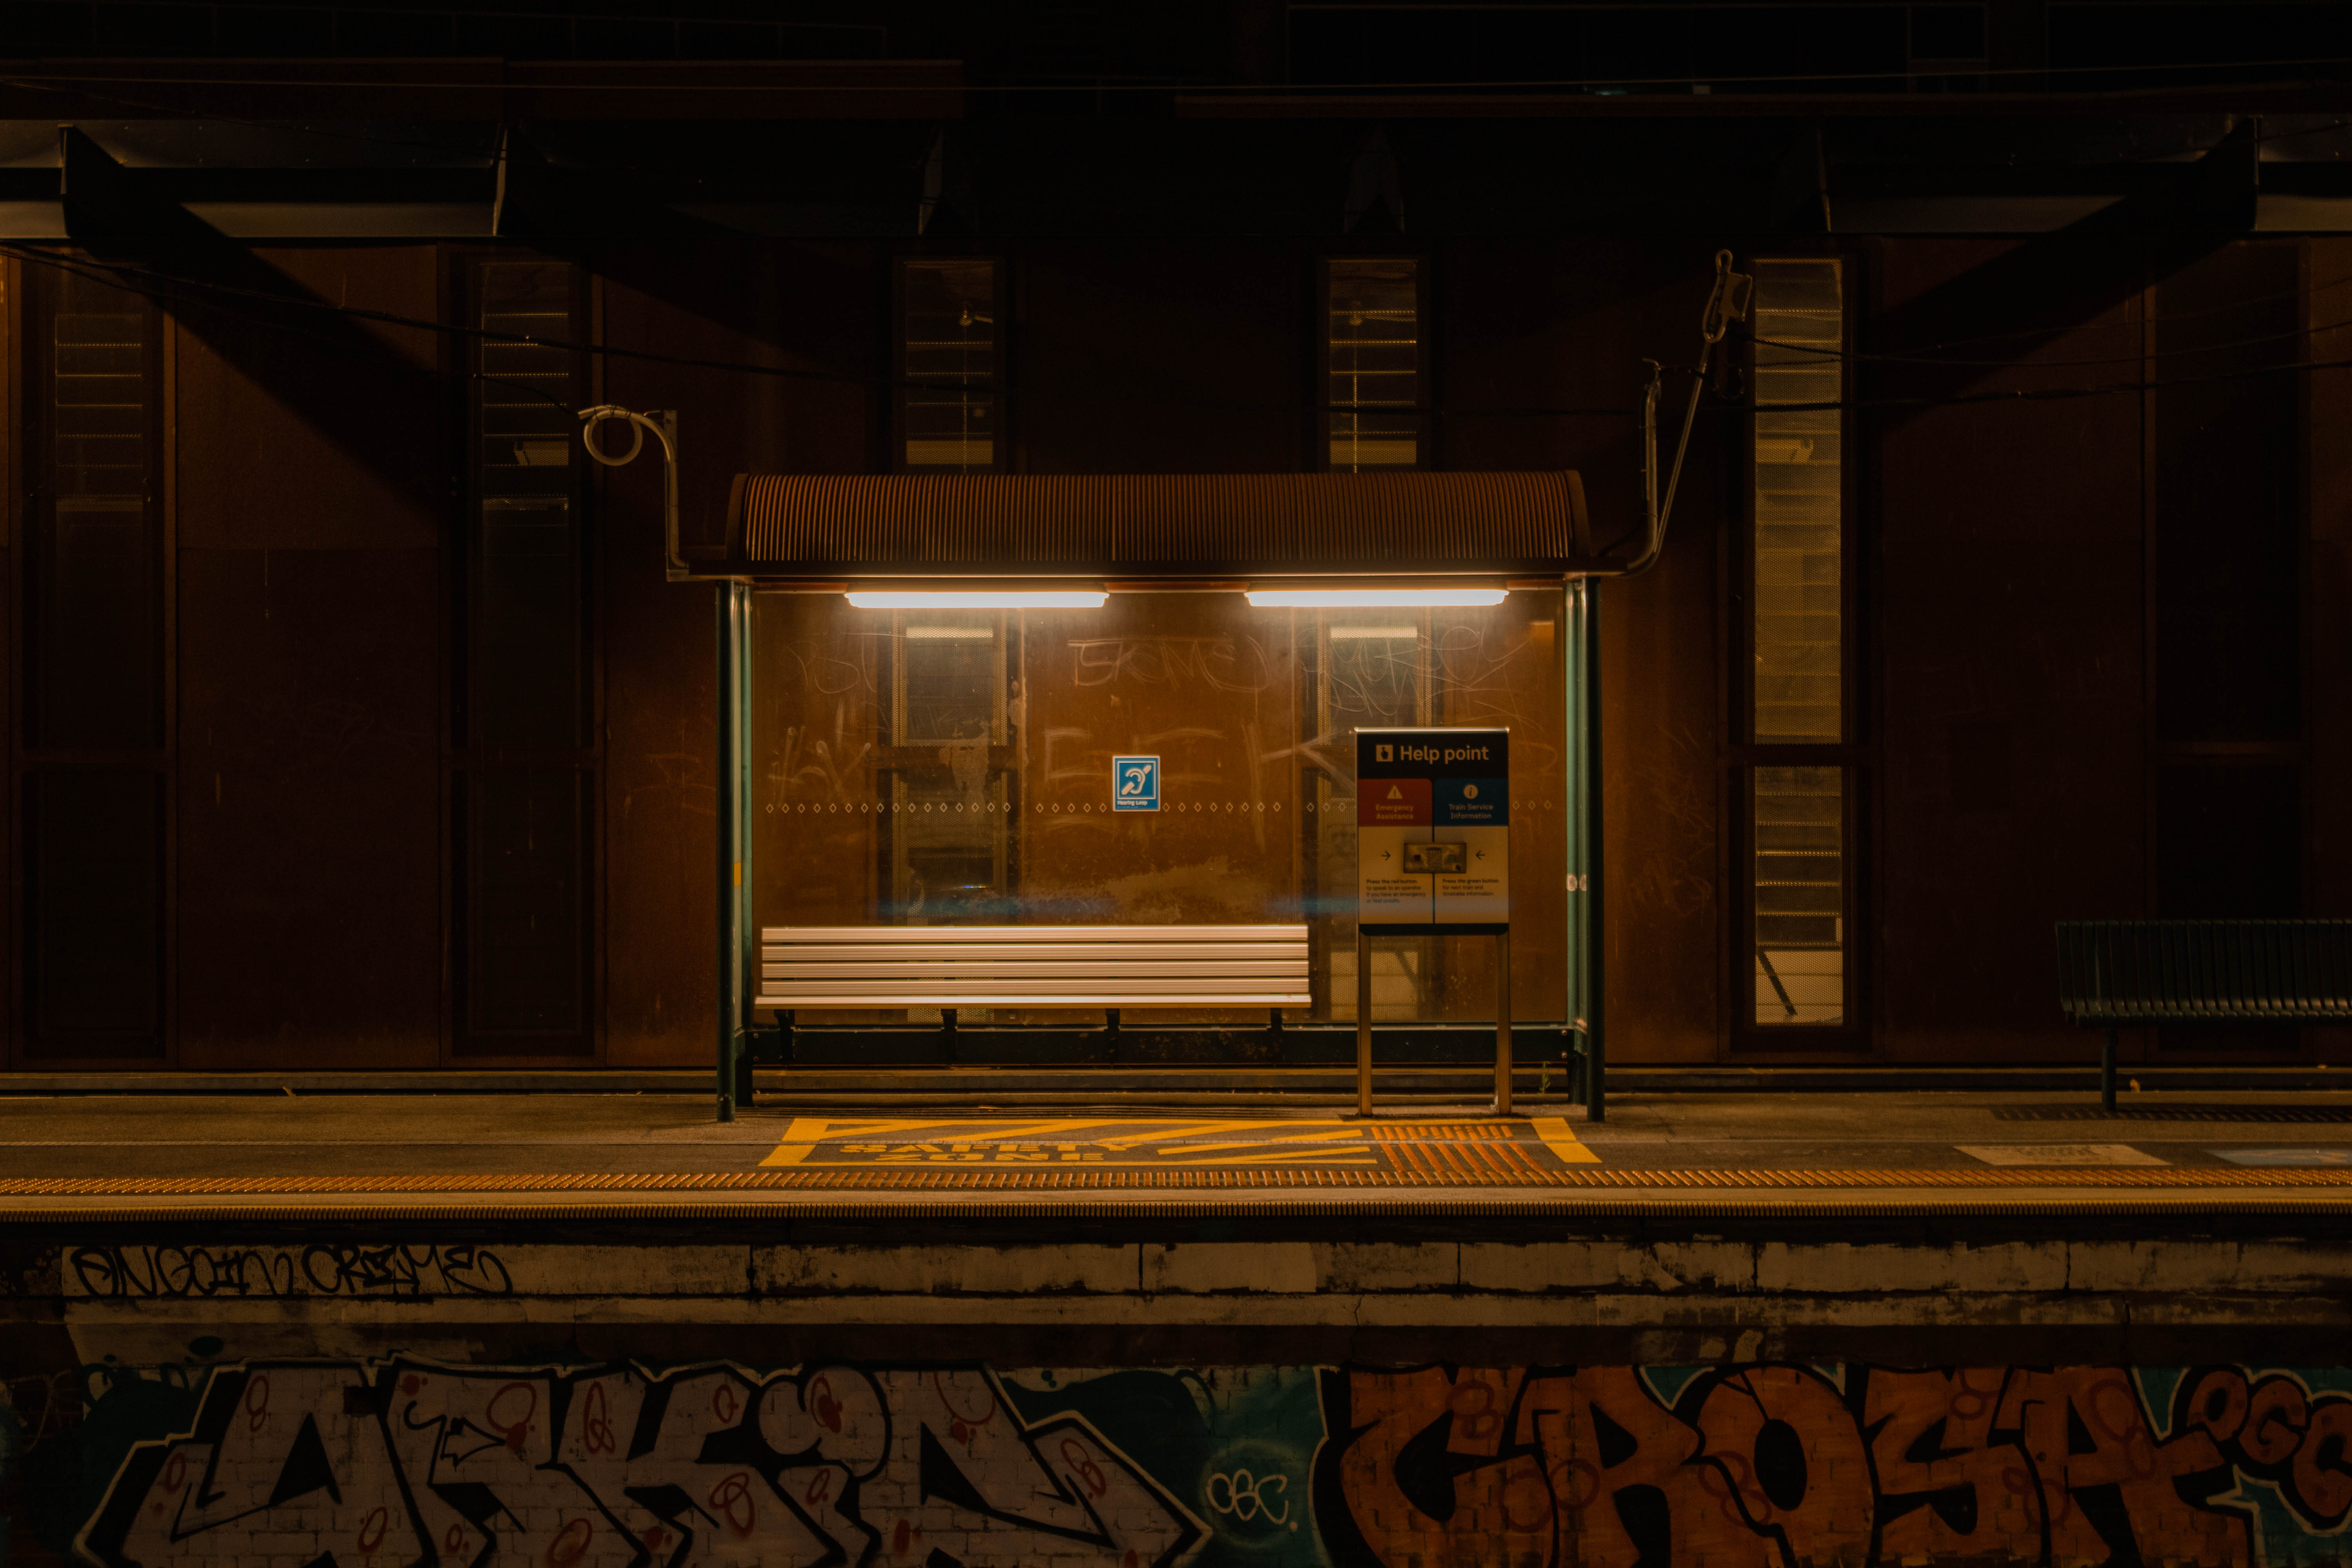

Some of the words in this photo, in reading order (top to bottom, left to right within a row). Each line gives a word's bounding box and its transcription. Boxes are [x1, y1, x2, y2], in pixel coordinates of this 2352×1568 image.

[1400, 744, 1440, 765] Help
[1444, 744, 1489, 765] point
[1375, 804, 1414, 813] Emergency
[839, 1144, 1144, 1153] SAFETY
